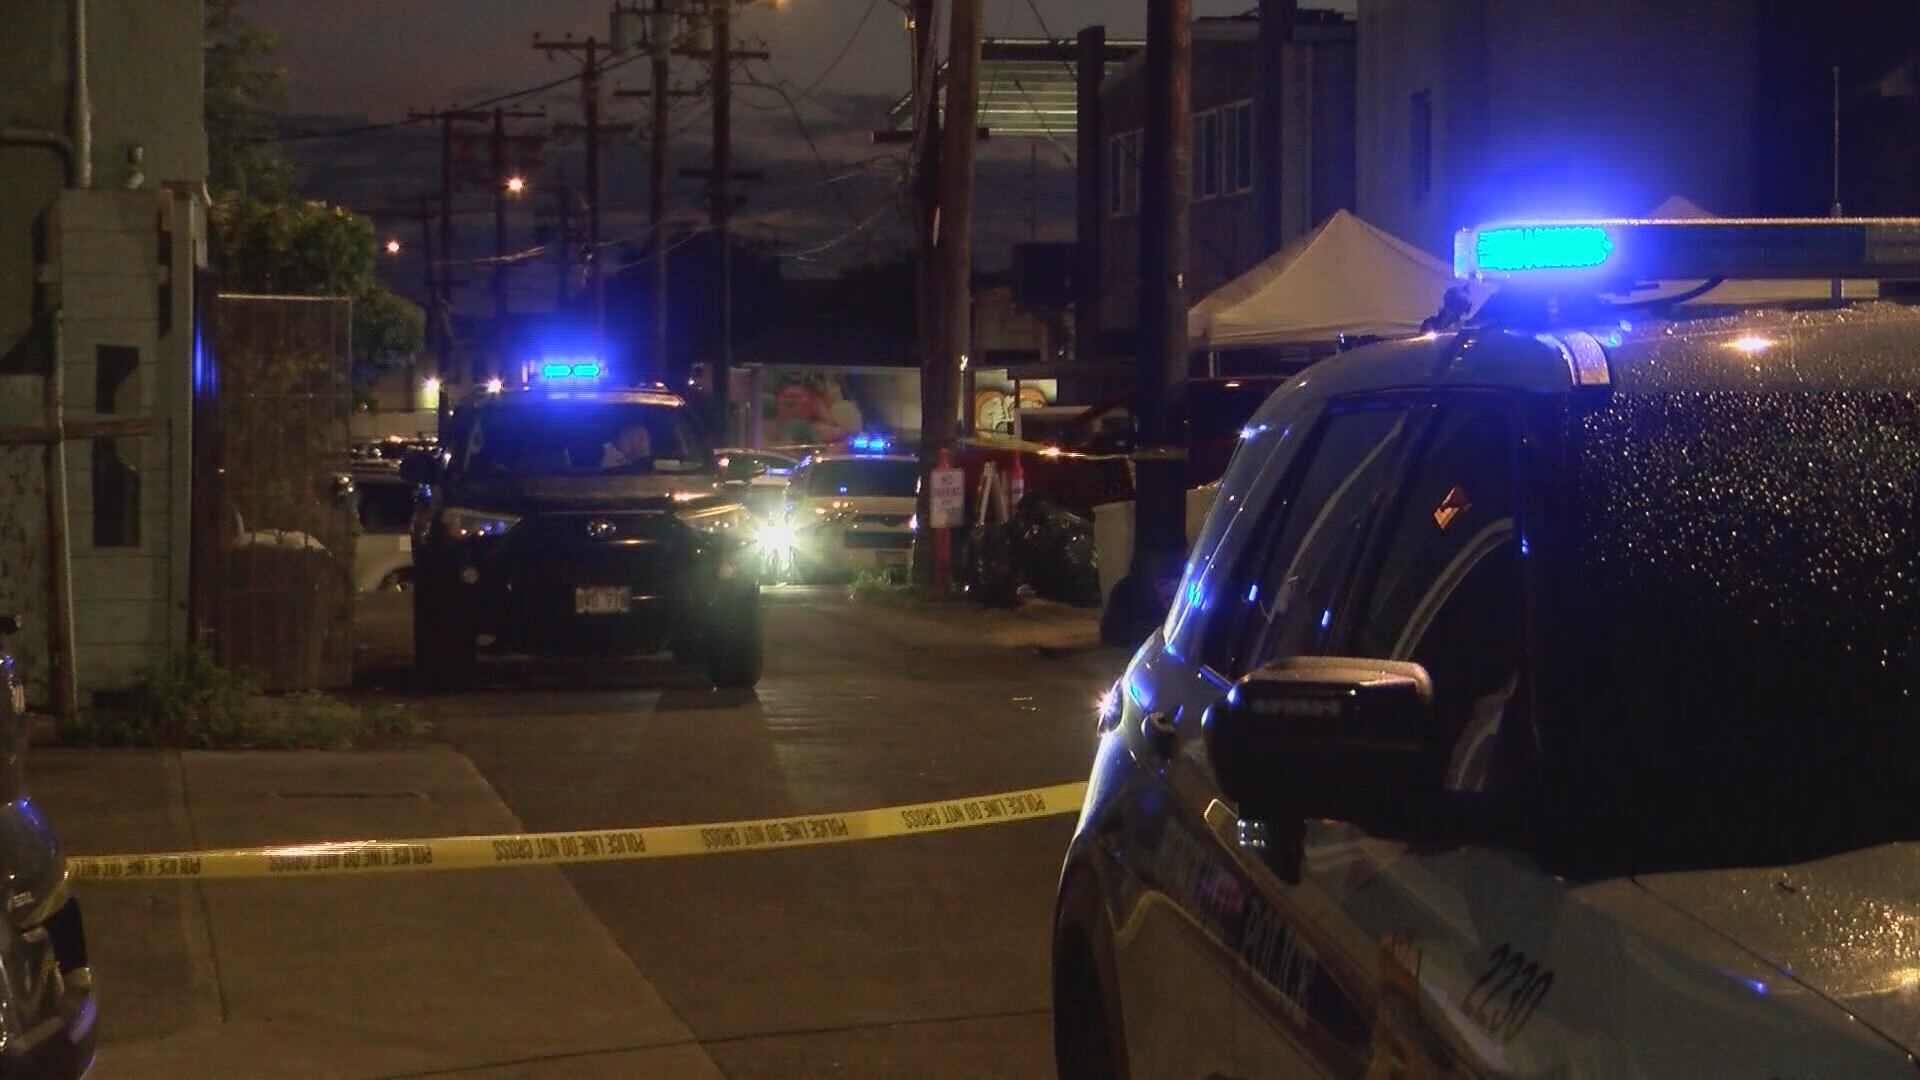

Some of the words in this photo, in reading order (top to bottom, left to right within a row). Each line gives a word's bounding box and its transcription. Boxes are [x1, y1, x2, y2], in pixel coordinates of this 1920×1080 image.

[942, 804, 965, 824] NOT
[963, 802, 982, 819] DO
[979, 799, 1008, 817] LINE
[1005, 794, 1046, 814] POLICE
[808, 818, 849, 838] POLICE
[902, 807, 941, 829] CROSS
[702, 828, 741, 849] CROSS
[743, 826, 765, 846] NOT
[765, 823, 784, 843] DO
[781, 821, 808, 842] LINE
[493, 839, 534, 861] CROSS
[537, 838, 559, 858] NOT
[560, 837, 579, 857] DO
[578, 835, 605, 856] LINE
[606, 834, 646, 854] POLICE
[361, 848, 388, 867] LINE
[393, 846, 433, 865] POLICE
[1242, 896, 1317, 1003] POLICE
[1463, 942, 1555, 1045] 2230
